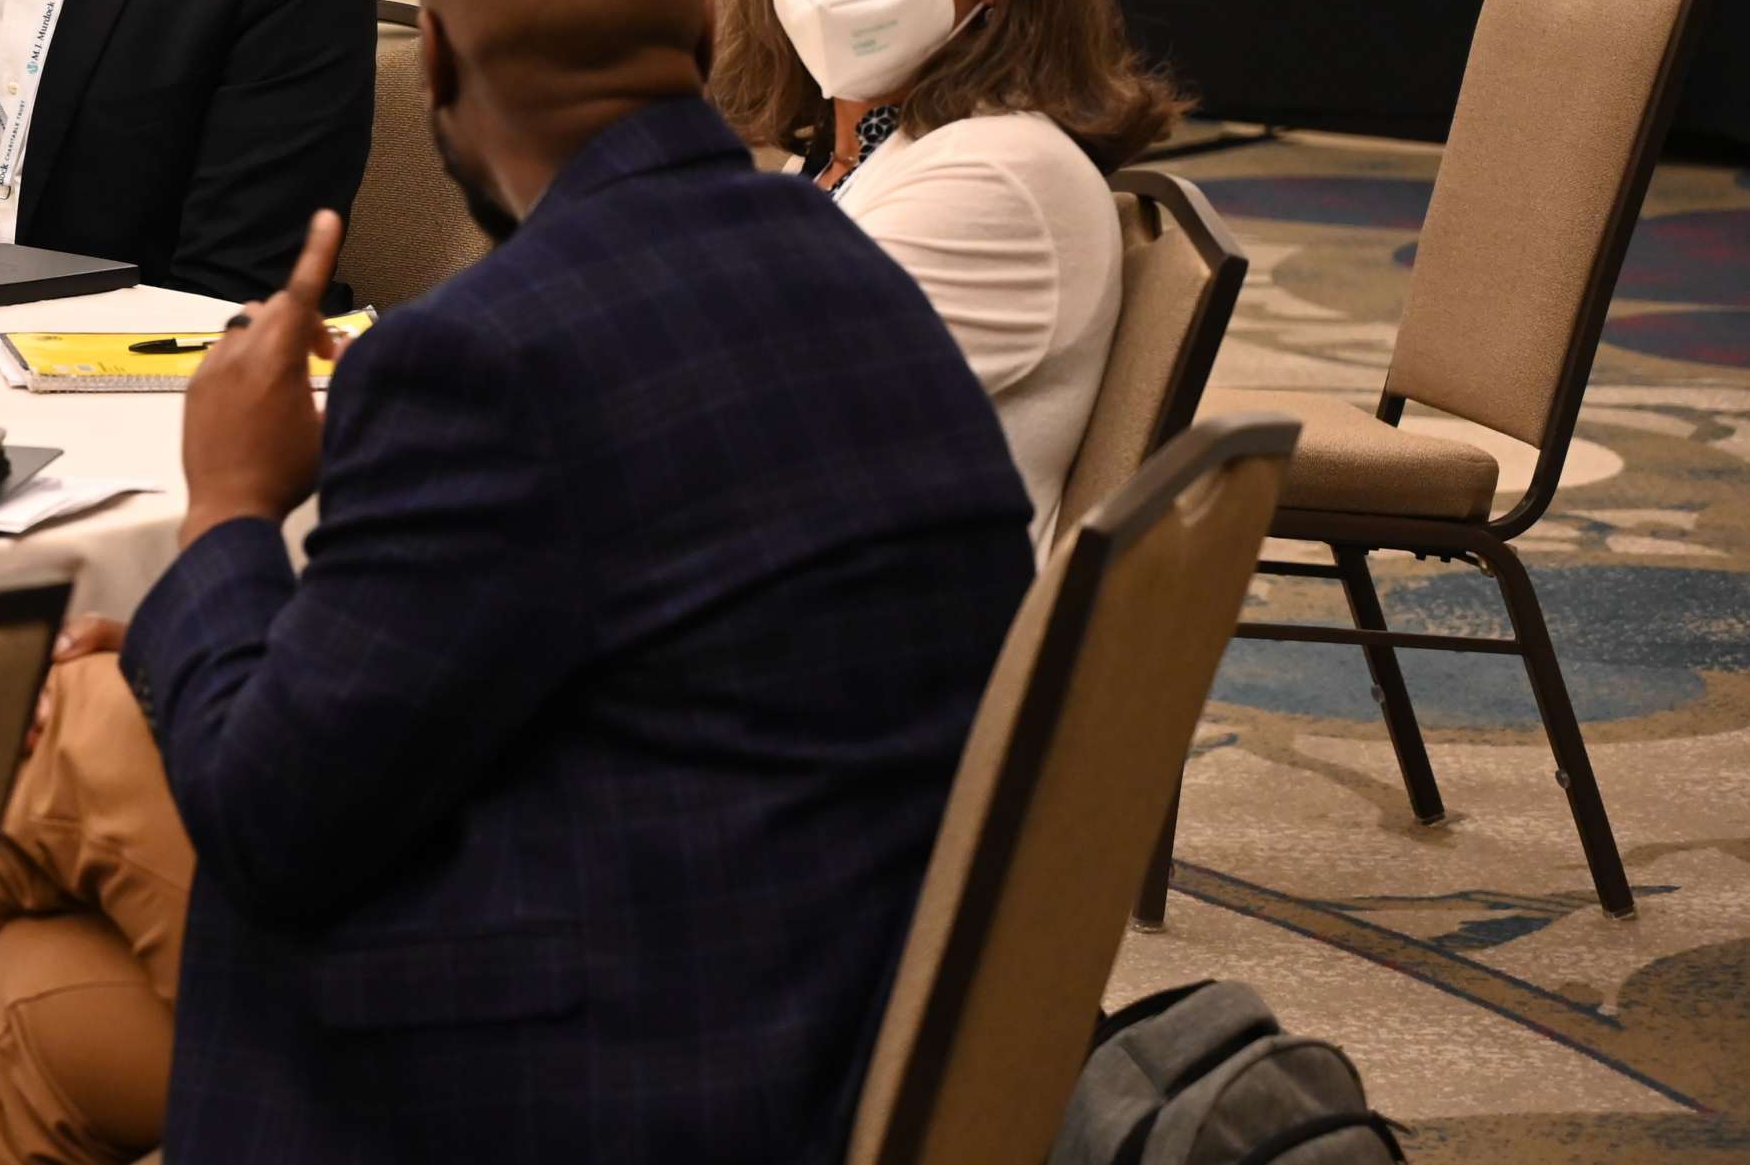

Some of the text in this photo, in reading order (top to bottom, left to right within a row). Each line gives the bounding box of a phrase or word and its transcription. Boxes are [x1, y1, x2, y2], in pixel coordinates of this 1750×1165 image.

[37, 1, 55, 41] Murdock
[4, 122, 20, 162] CHARITABLE
[16, 100, 26, 119] TRUST
